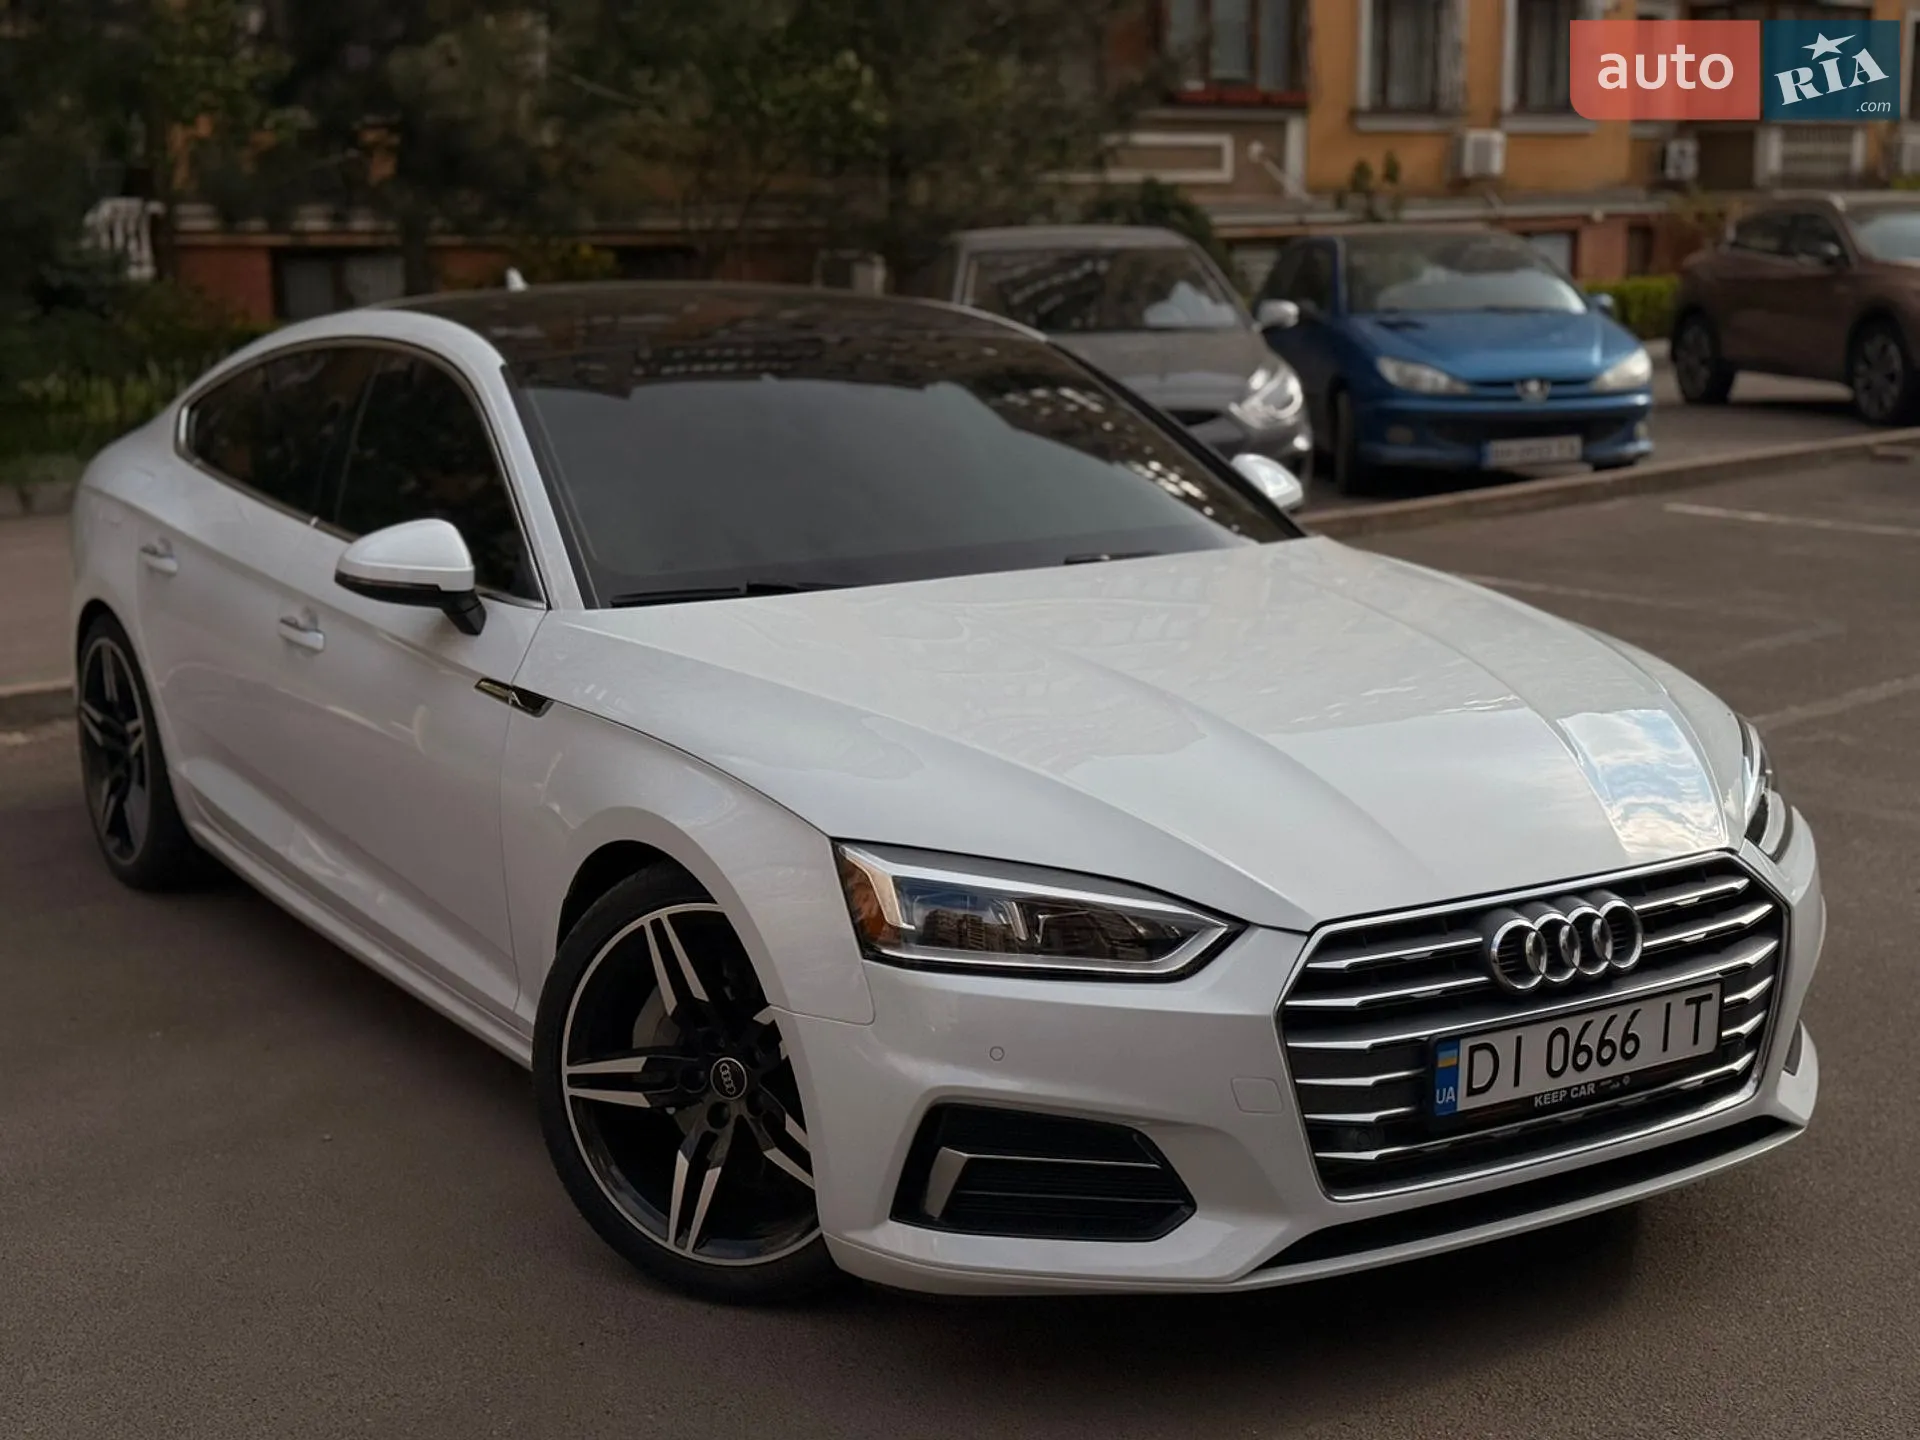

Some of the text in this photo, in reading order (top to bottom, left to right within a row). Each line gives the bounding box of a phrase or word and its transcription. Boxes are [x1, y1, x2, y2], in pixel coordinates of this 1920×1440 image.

[1466, 993, 1714, 1098] DI 0666 IT
[1435, 1086, 1456, 1105] UA
[1534, 1089, 1568, 1108] KEEP
[1570, 1082, 1596, 1099] CAR
